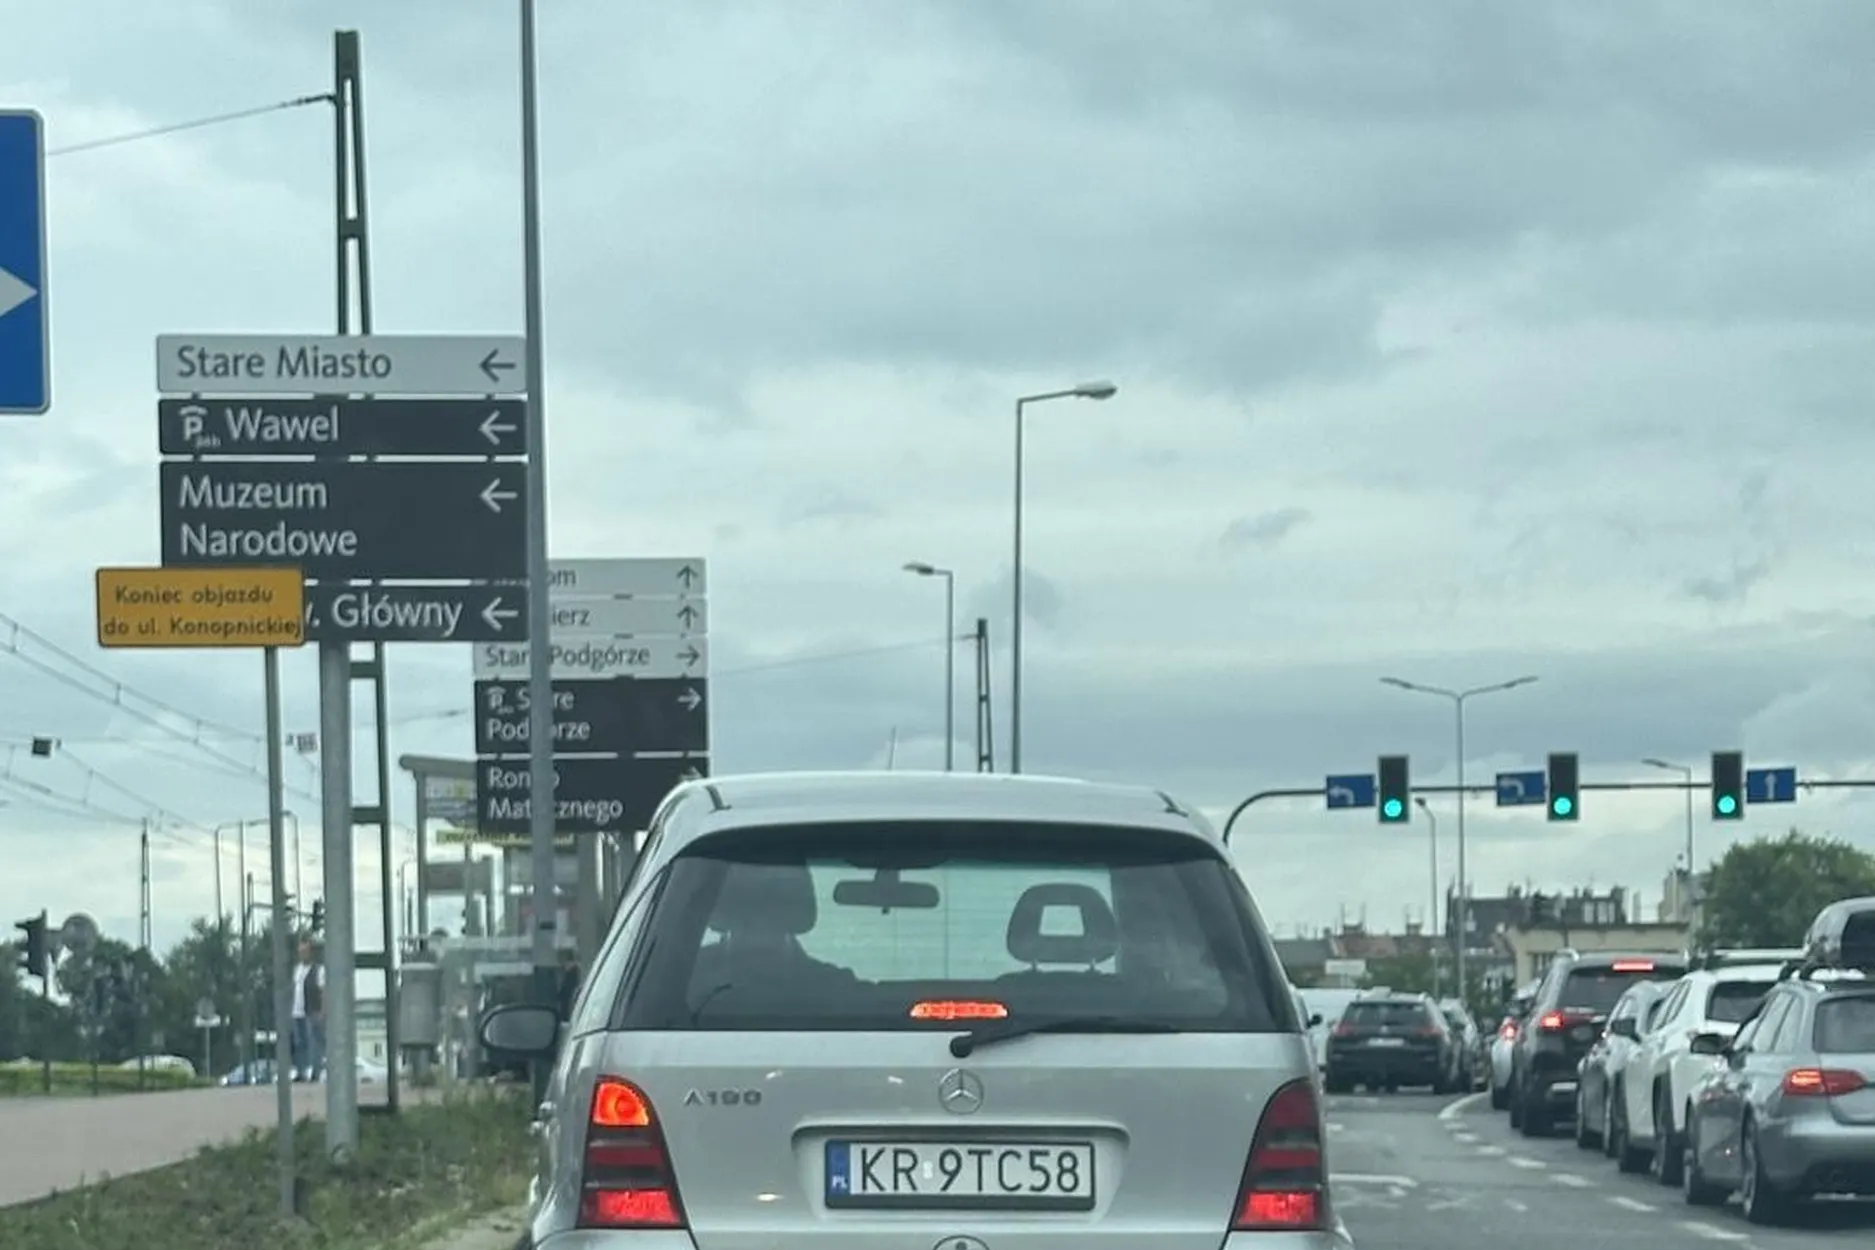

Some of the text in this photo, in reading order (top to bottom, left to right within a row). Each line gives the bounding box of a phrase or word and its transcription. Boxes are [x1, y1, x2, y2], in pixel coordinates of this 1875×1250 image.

[177, 345, 392, 378] Stare Miasto
[225, 404, 339, 441] Wawel
[178, 475, 328, 509] Muzeum
[180, 520, 358, 556] Narodowe
[115, 585, 273, 607] Koniec objazdu
[104, 617, 302, 638] do ul. Konopnickiej
[331, 591, 464, 637] Główny
[485, 643, 652, 673] Star Podgórze
[516, 687, 575, 711] Sre
[488, 766, 560, 789] Ron
[489, 797, 624, 826] Matznego
[832, 1175, 849, 1190] PL
[860, 1147, 1080, 1193] KR 9TC58
